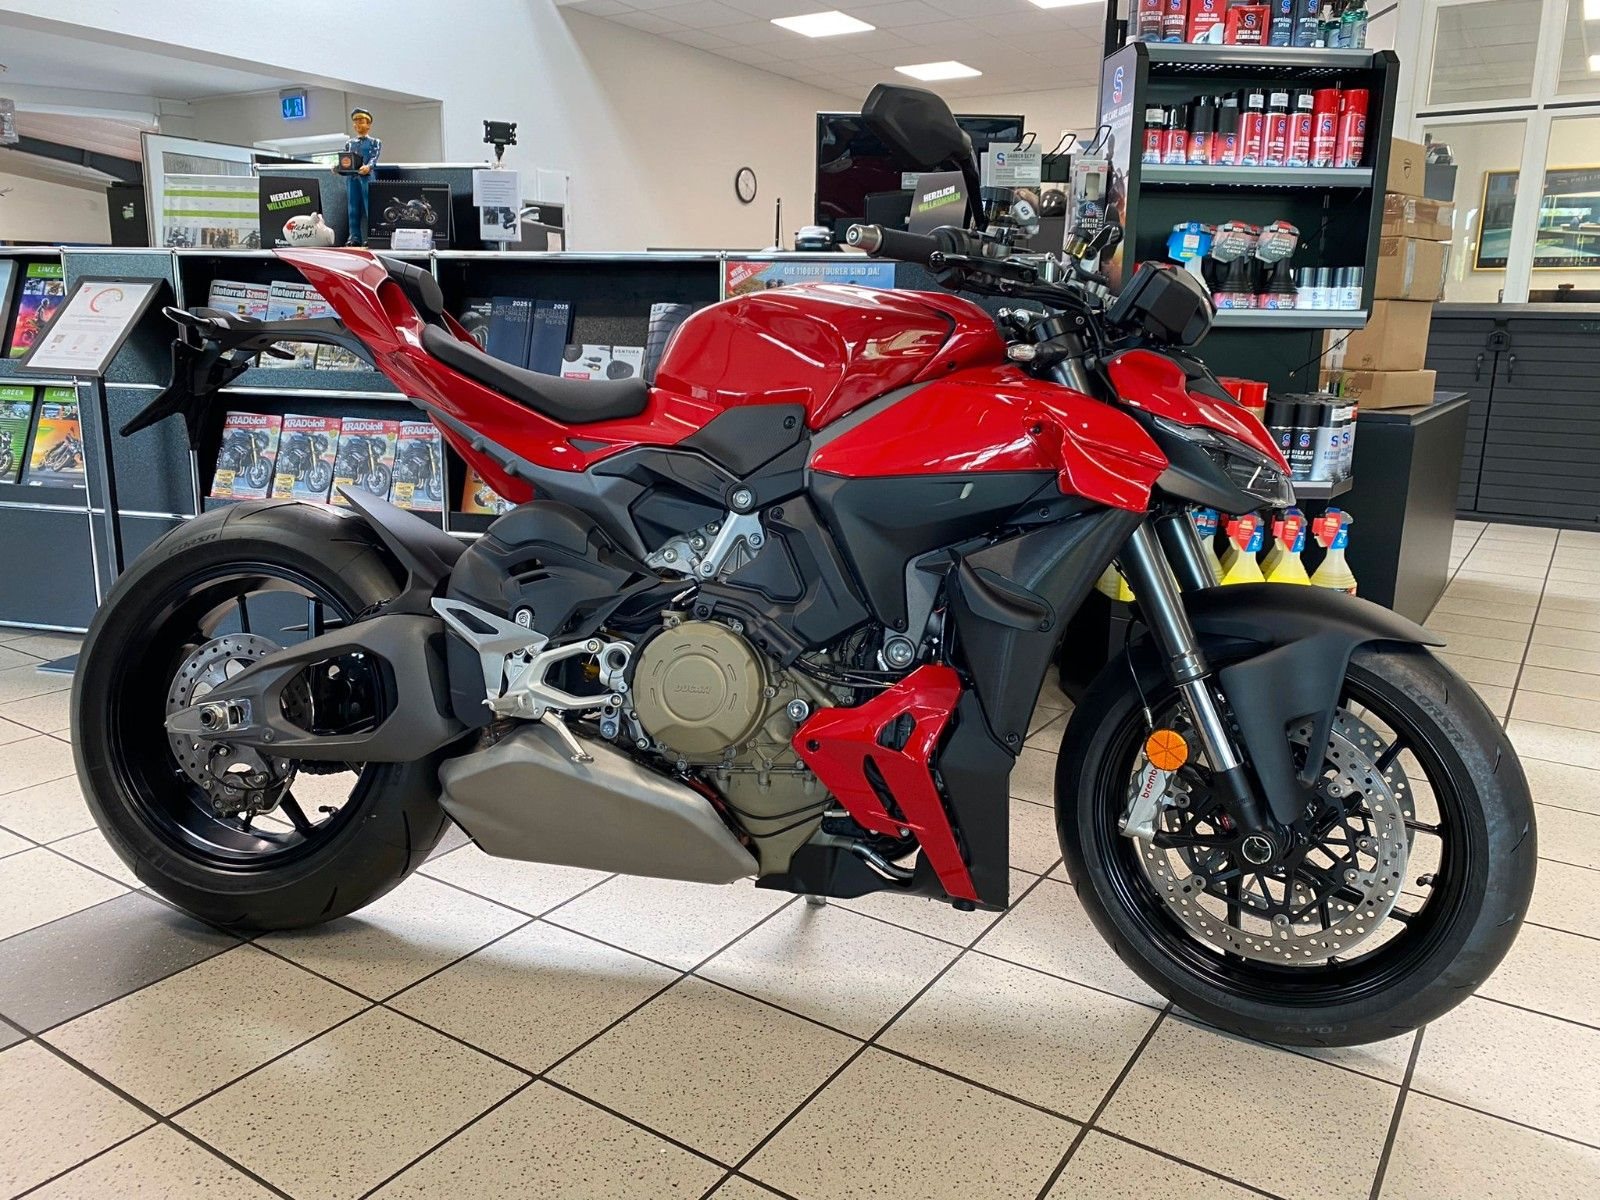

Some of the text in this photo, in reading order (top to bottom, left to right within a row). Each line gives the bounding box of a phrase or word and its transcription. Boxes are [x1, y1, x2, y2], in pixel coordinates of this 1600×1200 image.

[270, 190, 303, 202] HERZLICH
[923, 185, 955, 202] HERZLICH
[266, 196, 311, 211] WILLKOMMEN
[918, 192, 960, 212] WILLKOMMEN
[212, 286, 267, 299] Motorrad Szene
[271, 287, 304, 299] Motorrad
[226, 416, 266, 425] KRADblatt
[284, 419, 325, 428] KRADblatt
[342, 422, 383, 431] KRADblatt
[674, 684, 712, 694] DUCATI
[1403, 684, 1465, 742] CORSA
[1141, 768, 1159, 798] bremb
